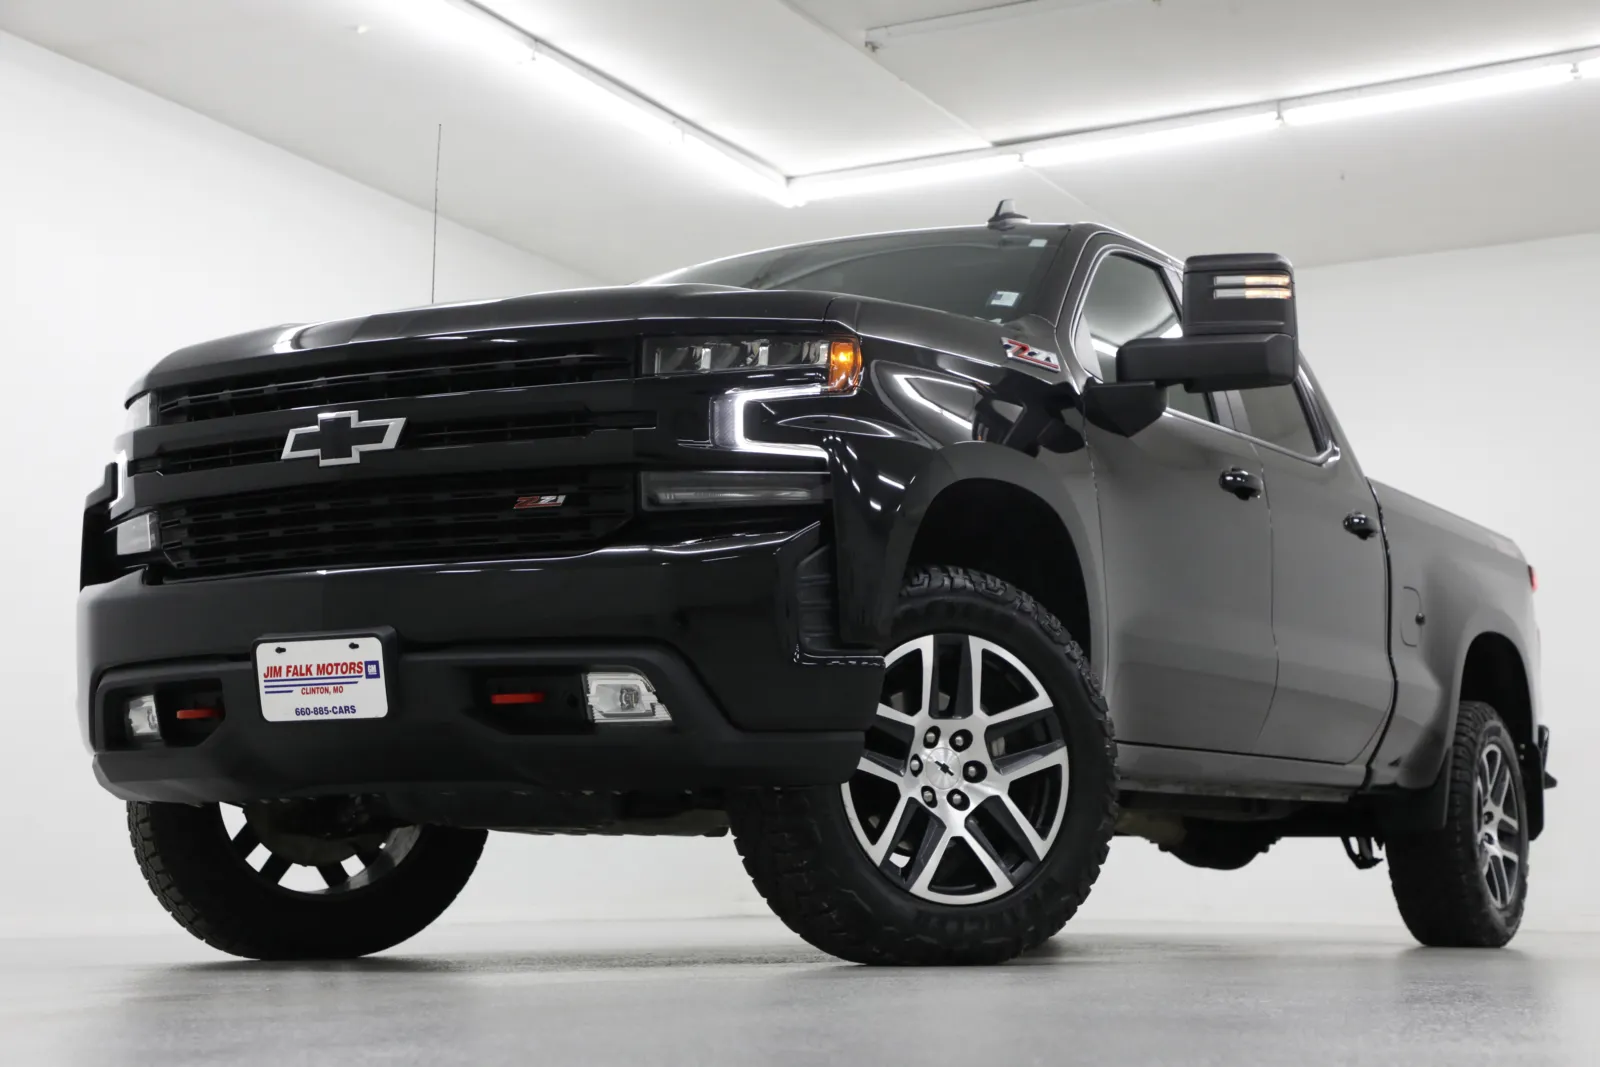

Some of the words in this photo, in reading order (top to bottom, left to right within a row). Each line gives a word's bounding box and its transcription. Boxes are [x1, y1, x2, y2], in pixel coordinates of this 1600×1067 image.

[263, 666, 282, 679] JIM
[286, 664, 313, 677] FALK
[316, 661, 364, 676] MOTORS
[367, 664, 378, 675] GM
[300, 686, 332, 696] CLINTON,
[333, 685, 344, 694] MO
[295, 705, 357, 717] 660-885-CARS
